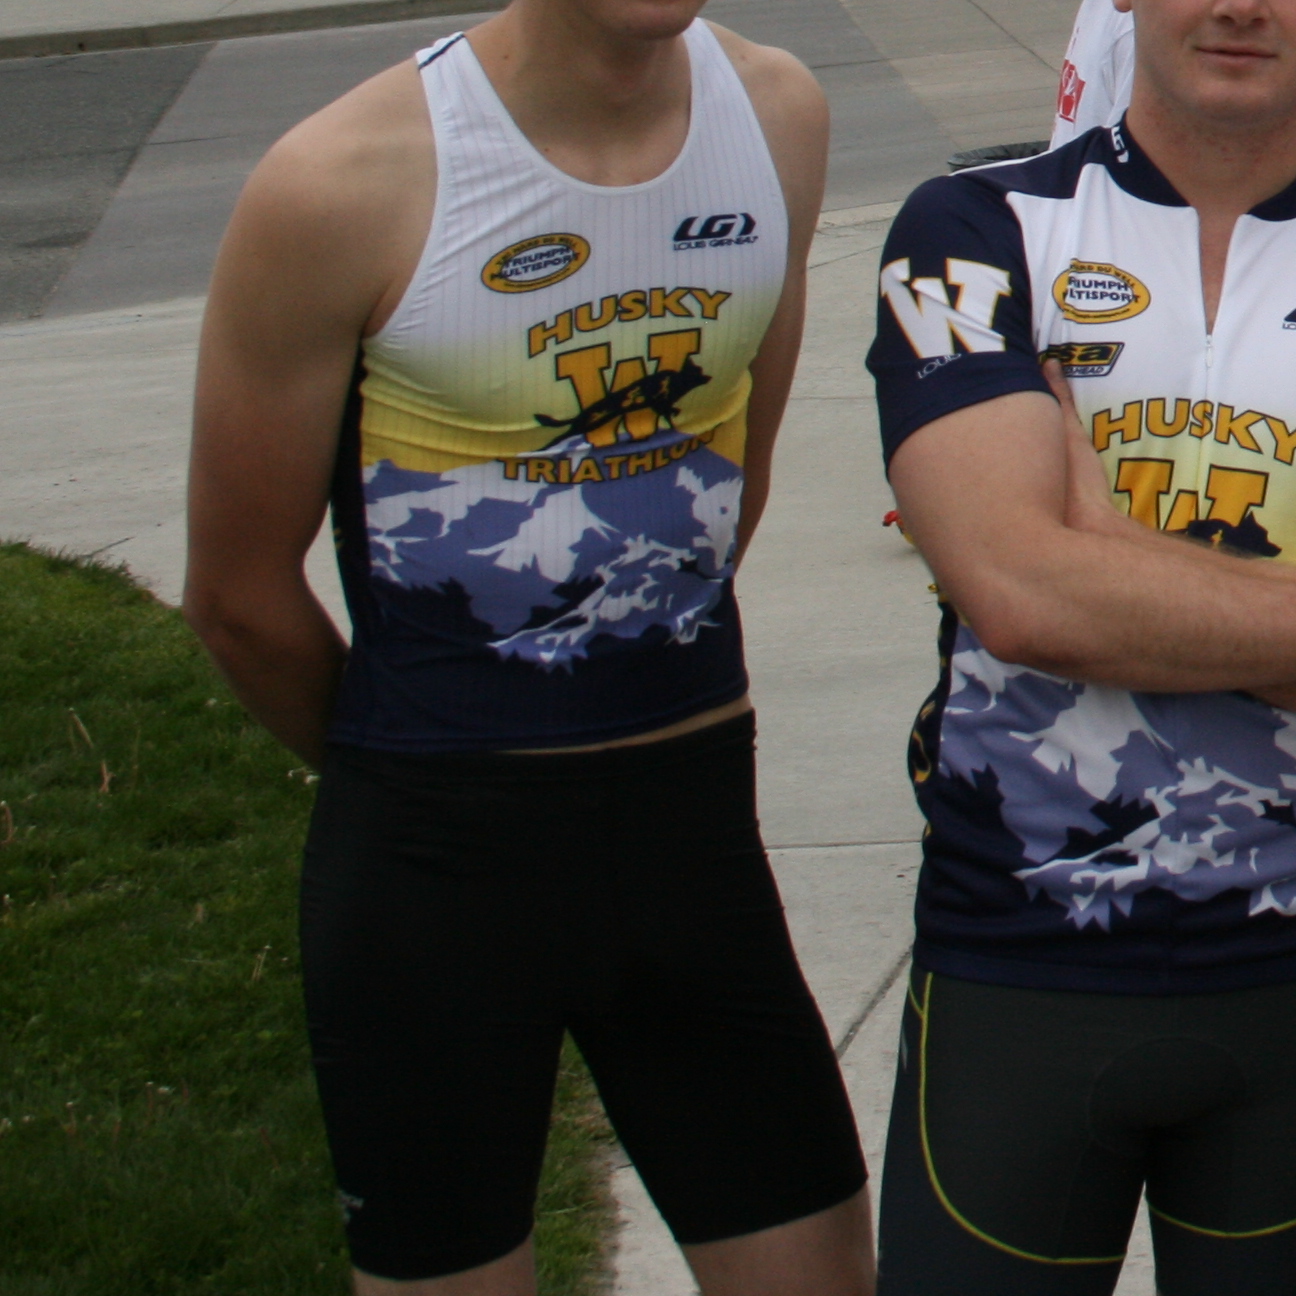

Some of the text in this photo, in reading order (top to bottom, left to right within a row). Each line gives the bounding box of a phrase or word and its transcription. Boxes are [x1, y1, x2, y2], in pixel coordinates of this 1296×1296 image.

[490, 253, 581, 280] MULTISPORT
[502, 245, 572, 268] TRIUMPH
[1063, 288, 1140, 303] LTISPORT
[1068, 276, 1129, 292] RIUMPH
[528, 287, 732, 359] HUSKY
[555, 328, 702, 447] W
